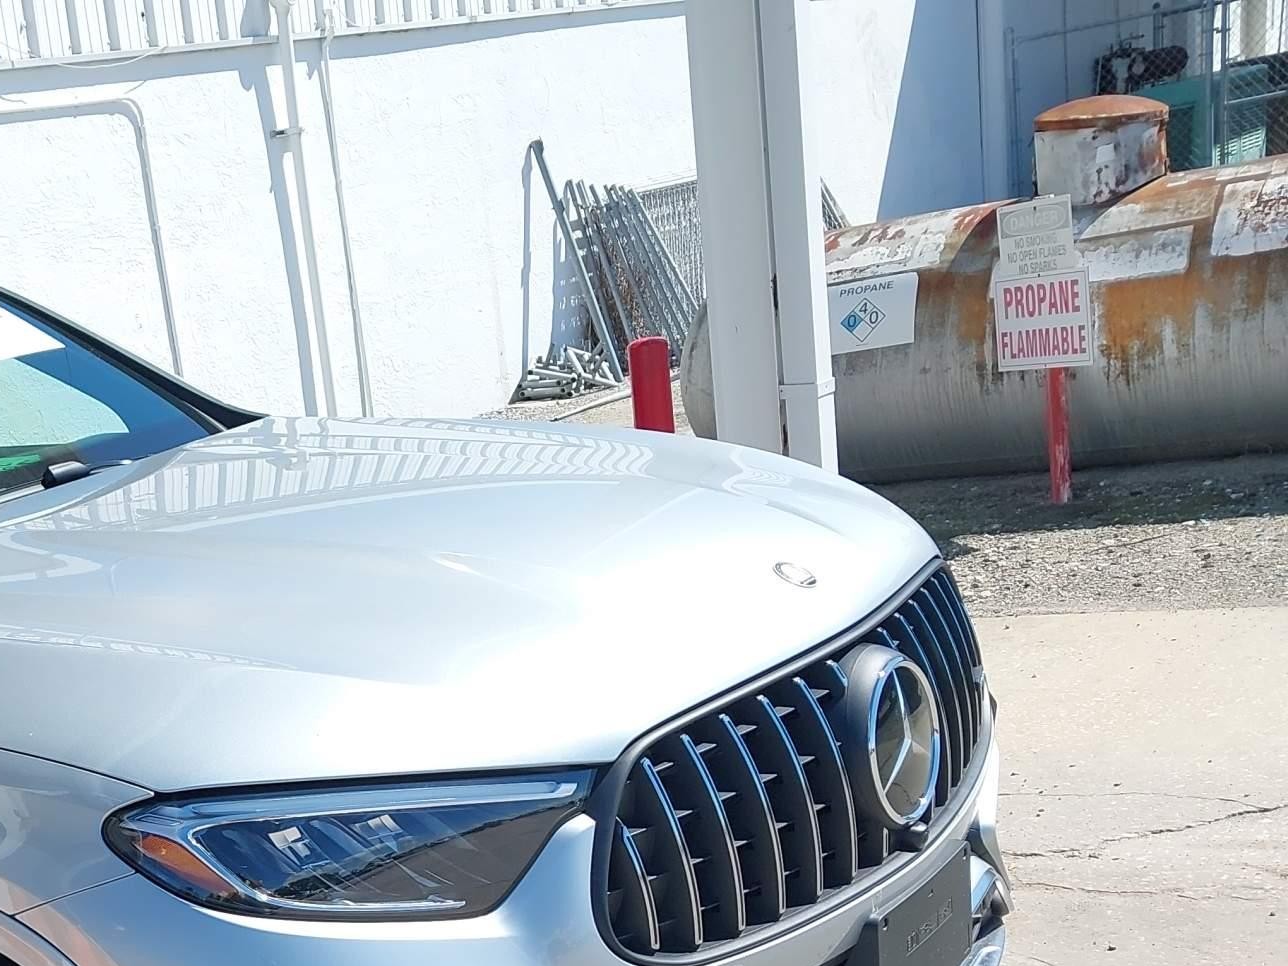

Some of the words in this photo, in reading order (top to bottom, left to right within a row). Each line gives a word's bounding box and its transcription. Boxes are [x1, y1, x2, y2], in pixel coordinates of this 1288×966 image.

[1015, 237, 1025, 249] NO
[1008, 252, 1018, 264] NO
[1019, 248, 1038, 262] OPEN
[1039, 244, 1067, 258] FLAMES
[1019, 263, 1029, 275] NO
[1030, 258, 1058, 273] SPARKS
[839, 280, 894, 298] PROPANE
[858, 301, 868, 314] 4
[1003, 279, 1081, 320] PROPANE
[847, 314, 857, 328] 0
[869, 310, 879, 324] 0
[1000, 324, 1087, 360] FLAMMABLE
